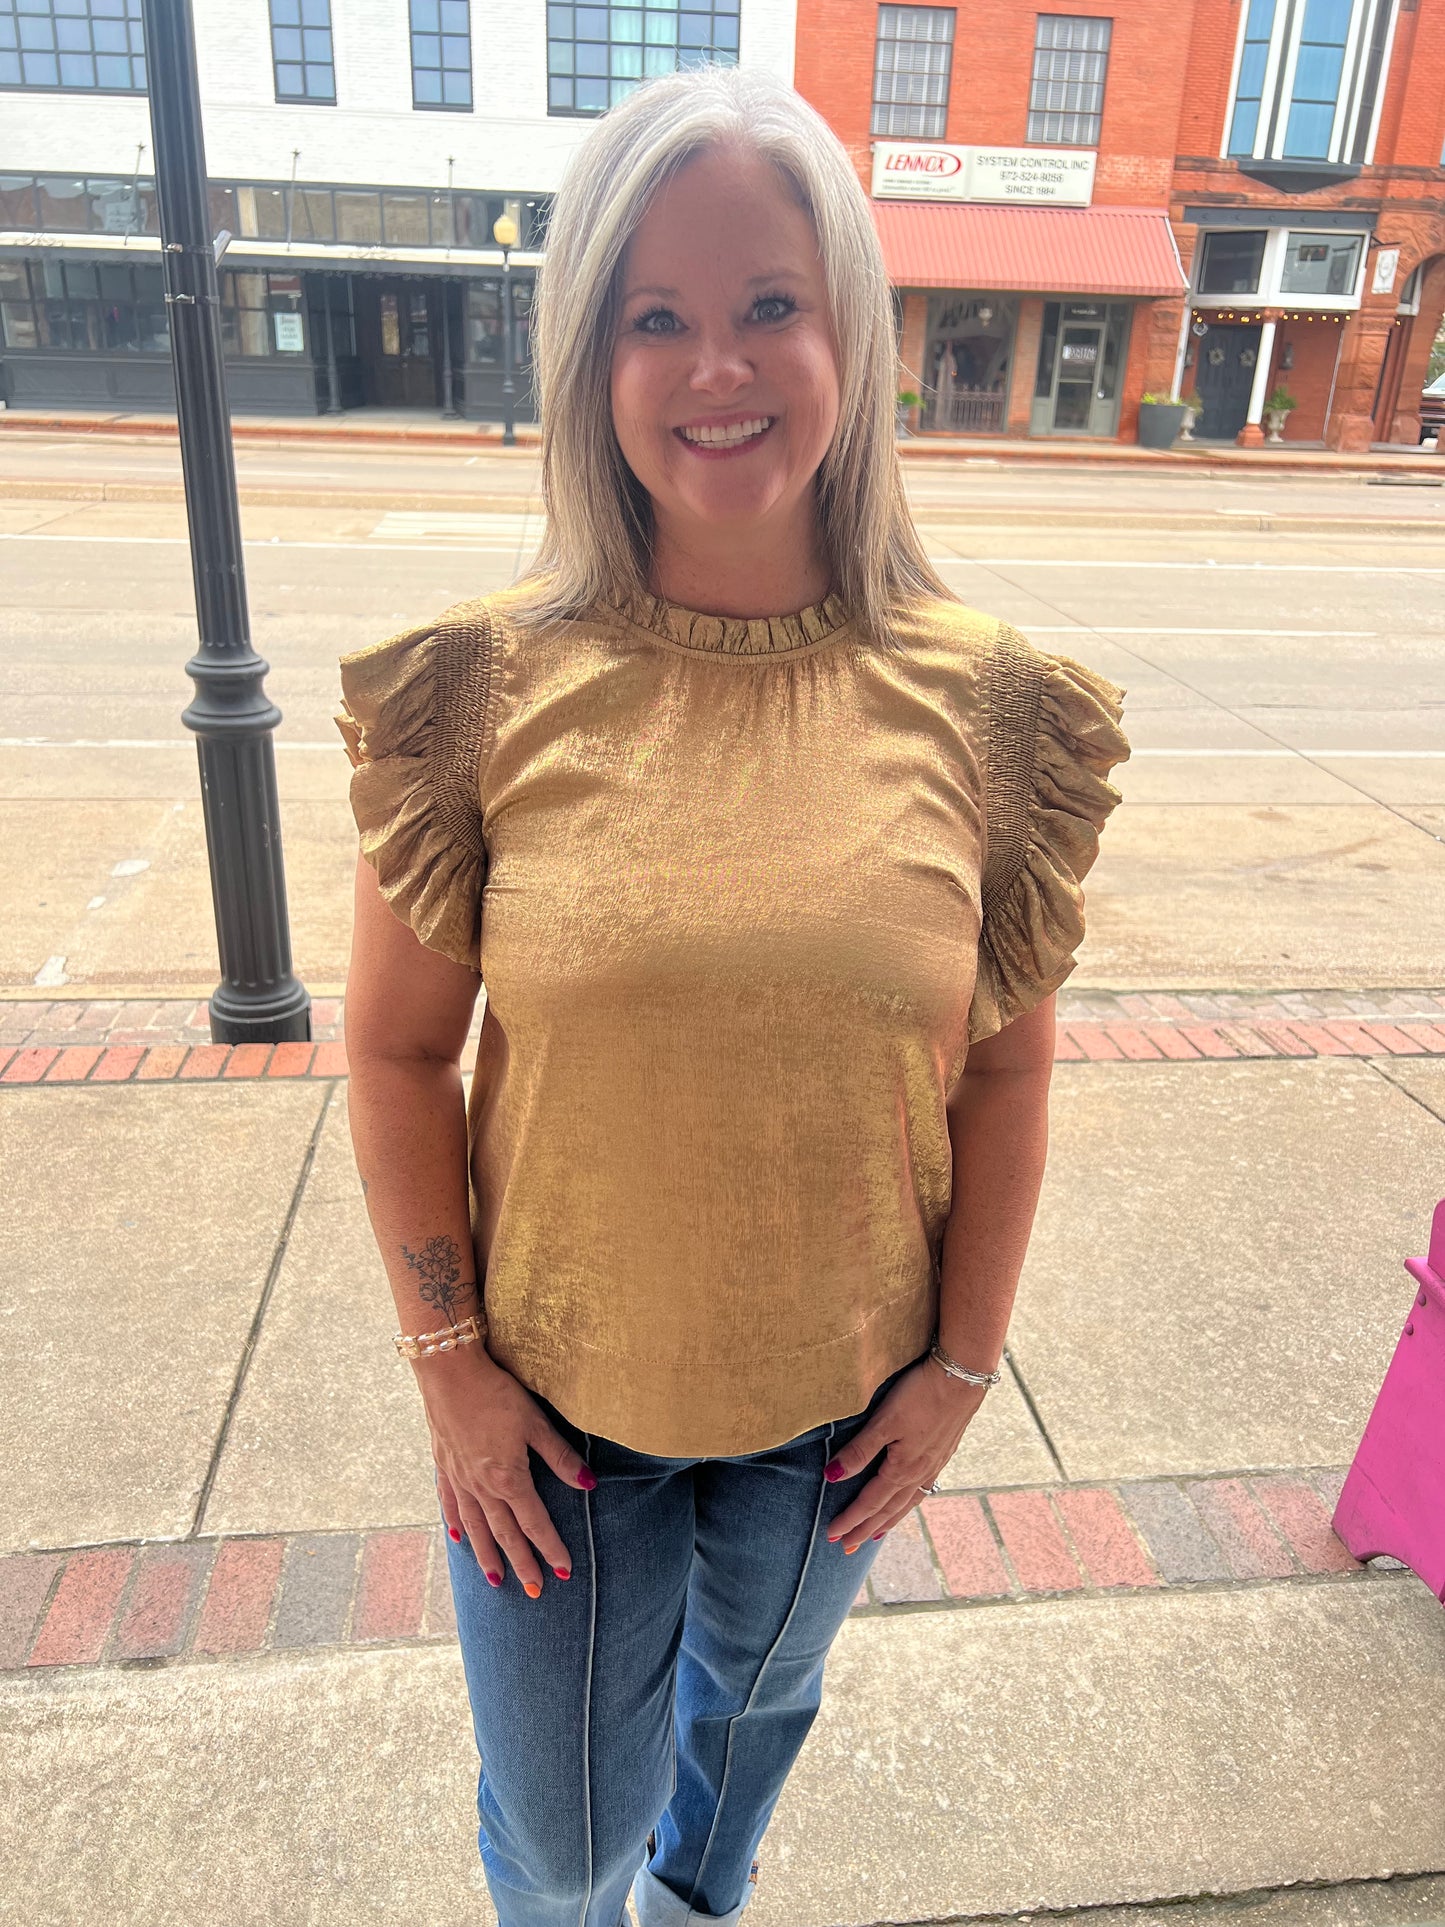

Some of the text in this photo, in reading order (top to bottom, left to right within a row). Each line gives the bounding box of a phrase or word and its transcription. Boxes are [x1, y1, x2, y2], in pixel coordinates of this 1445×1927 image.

[885, 153, 947, 172] LENNOX
[976, 155, 1090, 171] SYSTEM CONTROL INC
[1004, 184, 1035, 195] SINCE
